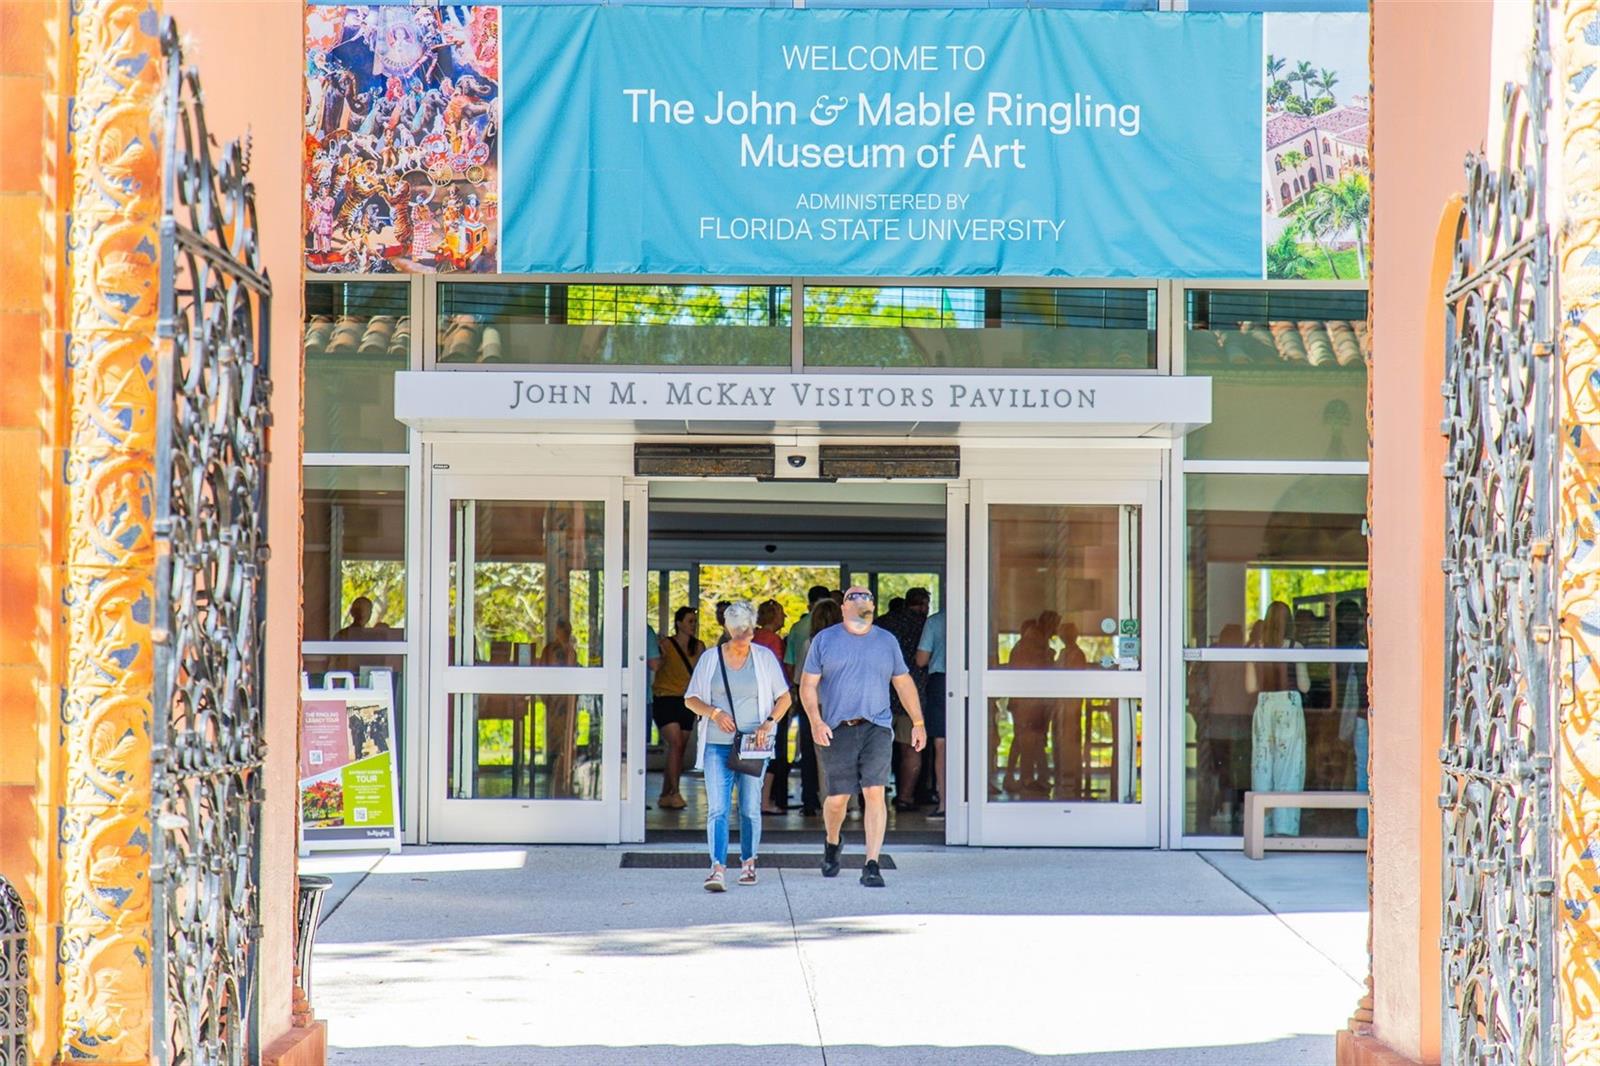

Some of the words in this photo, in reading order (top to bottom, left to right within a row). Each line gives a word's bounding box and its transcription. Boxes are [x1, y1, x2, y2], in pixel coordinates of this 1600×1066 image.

[782, 45, 937, 71] WELCOME
[946, 45, 985, 71] TO
[623, 88, 695, 125] The
[704, 90, 797, 126] John
[809, 94, 849, 126] &
[858, 91, 975, 126] Mable
[987, 91, 1140, 137] Ringling
[740, 134, 905, 168] Museum
[916, 134, 956, 168] of
[964, 135, 1026, 169] Art
[796, 193, 941, 210] ADMINISTERED
[946, 193, 969, 210] BY
[700, 217, 813, 240] FLORIDA
[820, 218, 900, 241] STATE
[908, 219, 1065, 241] UNIVERSITY
[509, 380, 592, 409] JOHN
[609, 381, 648, 405] M.
[791, 383, 934, 408] VISITORS
[950, 384, 1096, 409] PAVILION
[356, 775, 378, 783] TOUR
